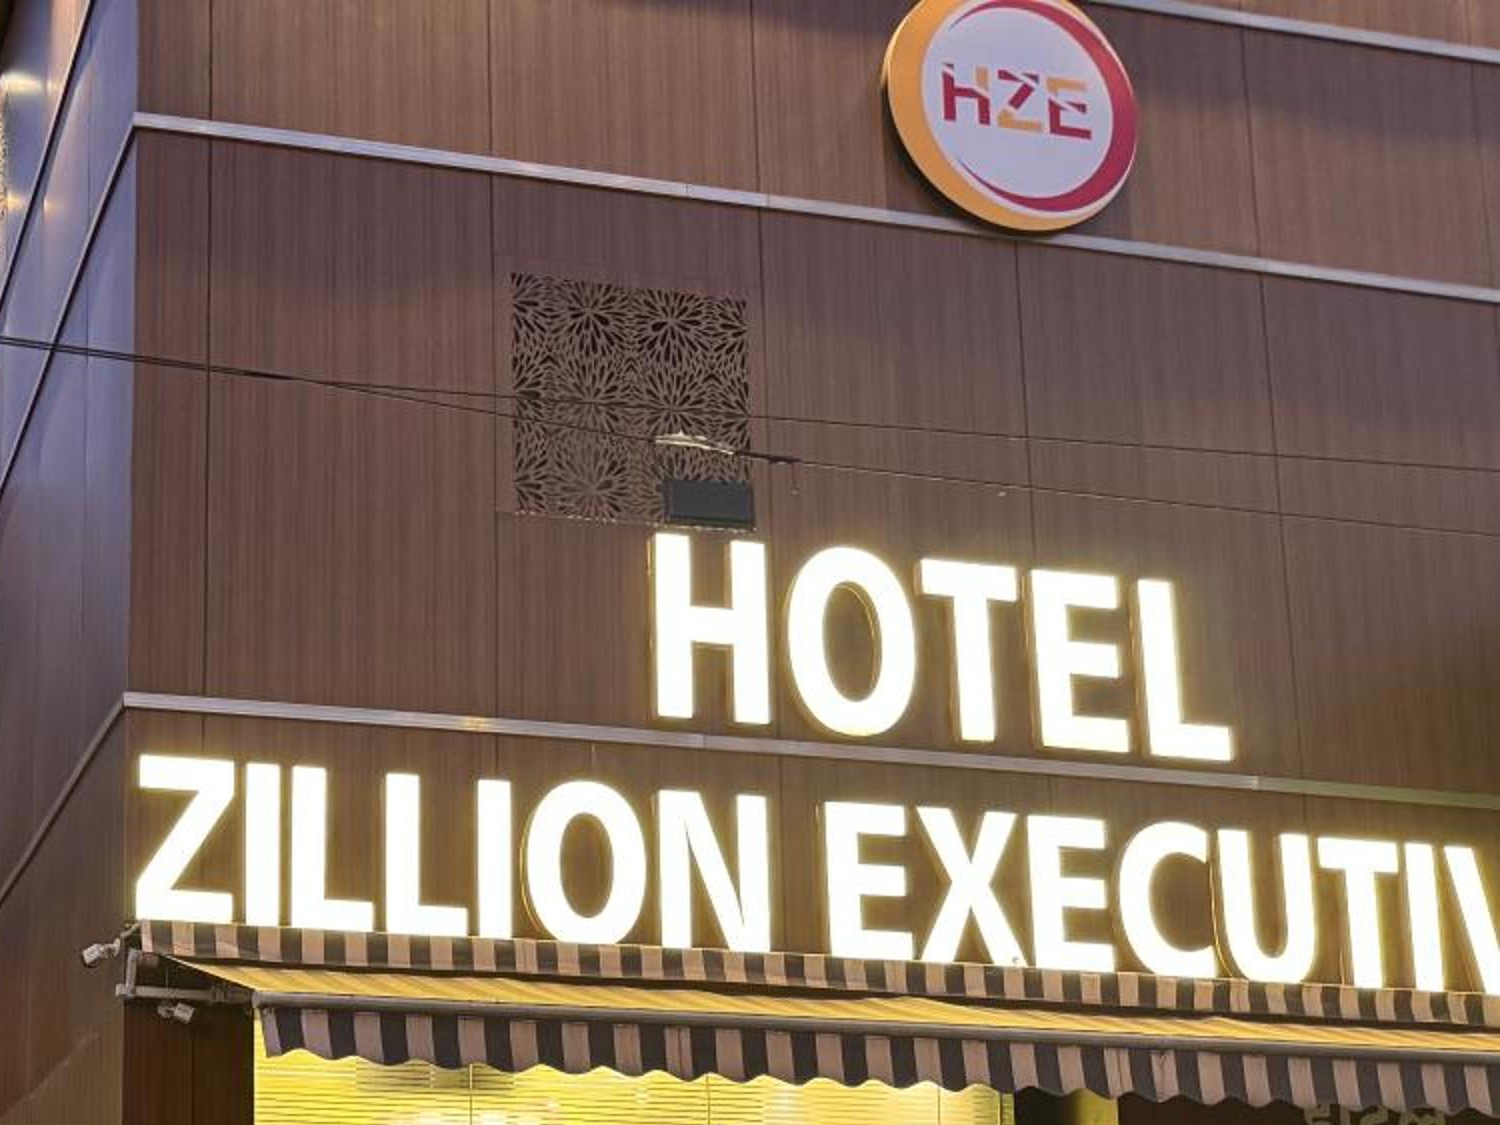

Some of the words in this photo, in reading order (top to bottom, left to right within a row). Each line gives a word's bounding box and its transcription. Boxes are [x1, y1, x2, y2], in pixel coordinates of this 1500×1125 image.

[942, 62, 1092, 140] HZE
[653, 532, 1234, 763] HOTEL
[133, 753, 773, 956] ZILLION
